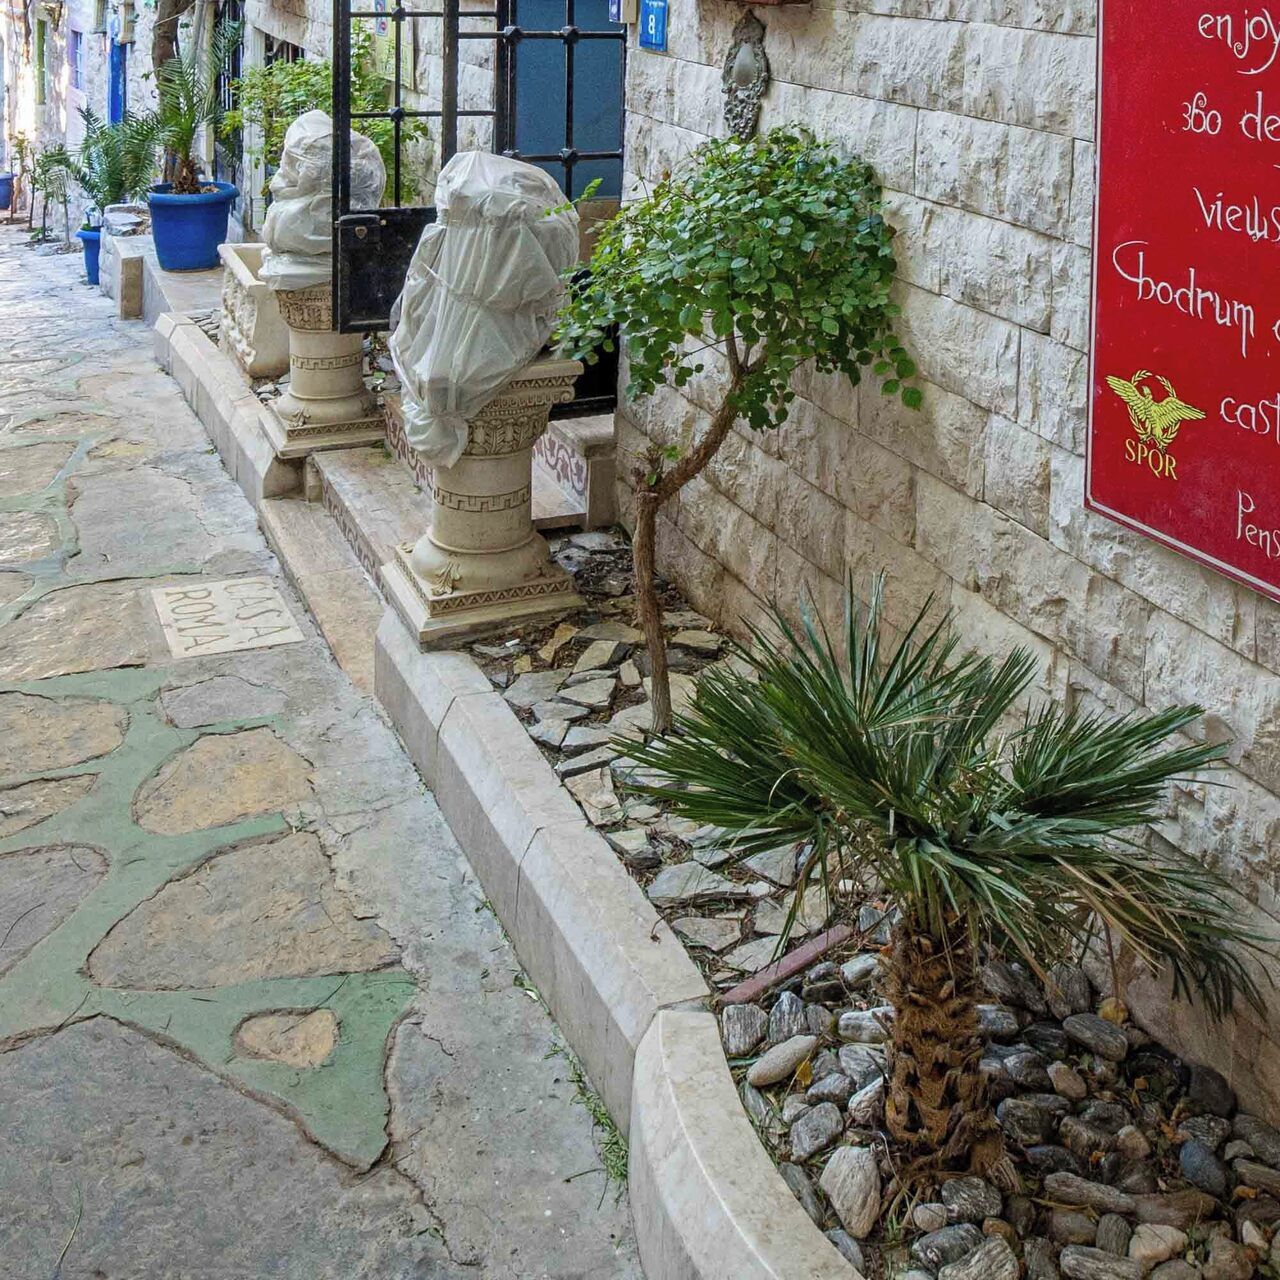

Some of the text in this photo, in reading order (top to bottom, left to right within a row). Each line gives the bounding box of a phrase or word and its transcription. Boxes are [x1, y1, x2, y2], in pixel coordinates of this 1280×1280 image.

[648, 14, 656, 35] 8
[1182, 91, 1222, 135] 360
[1124, 438, 1179, 481] SPQR
[164, 587, 230, 652] ROMA
[222, 580, 291, 644] CASA
